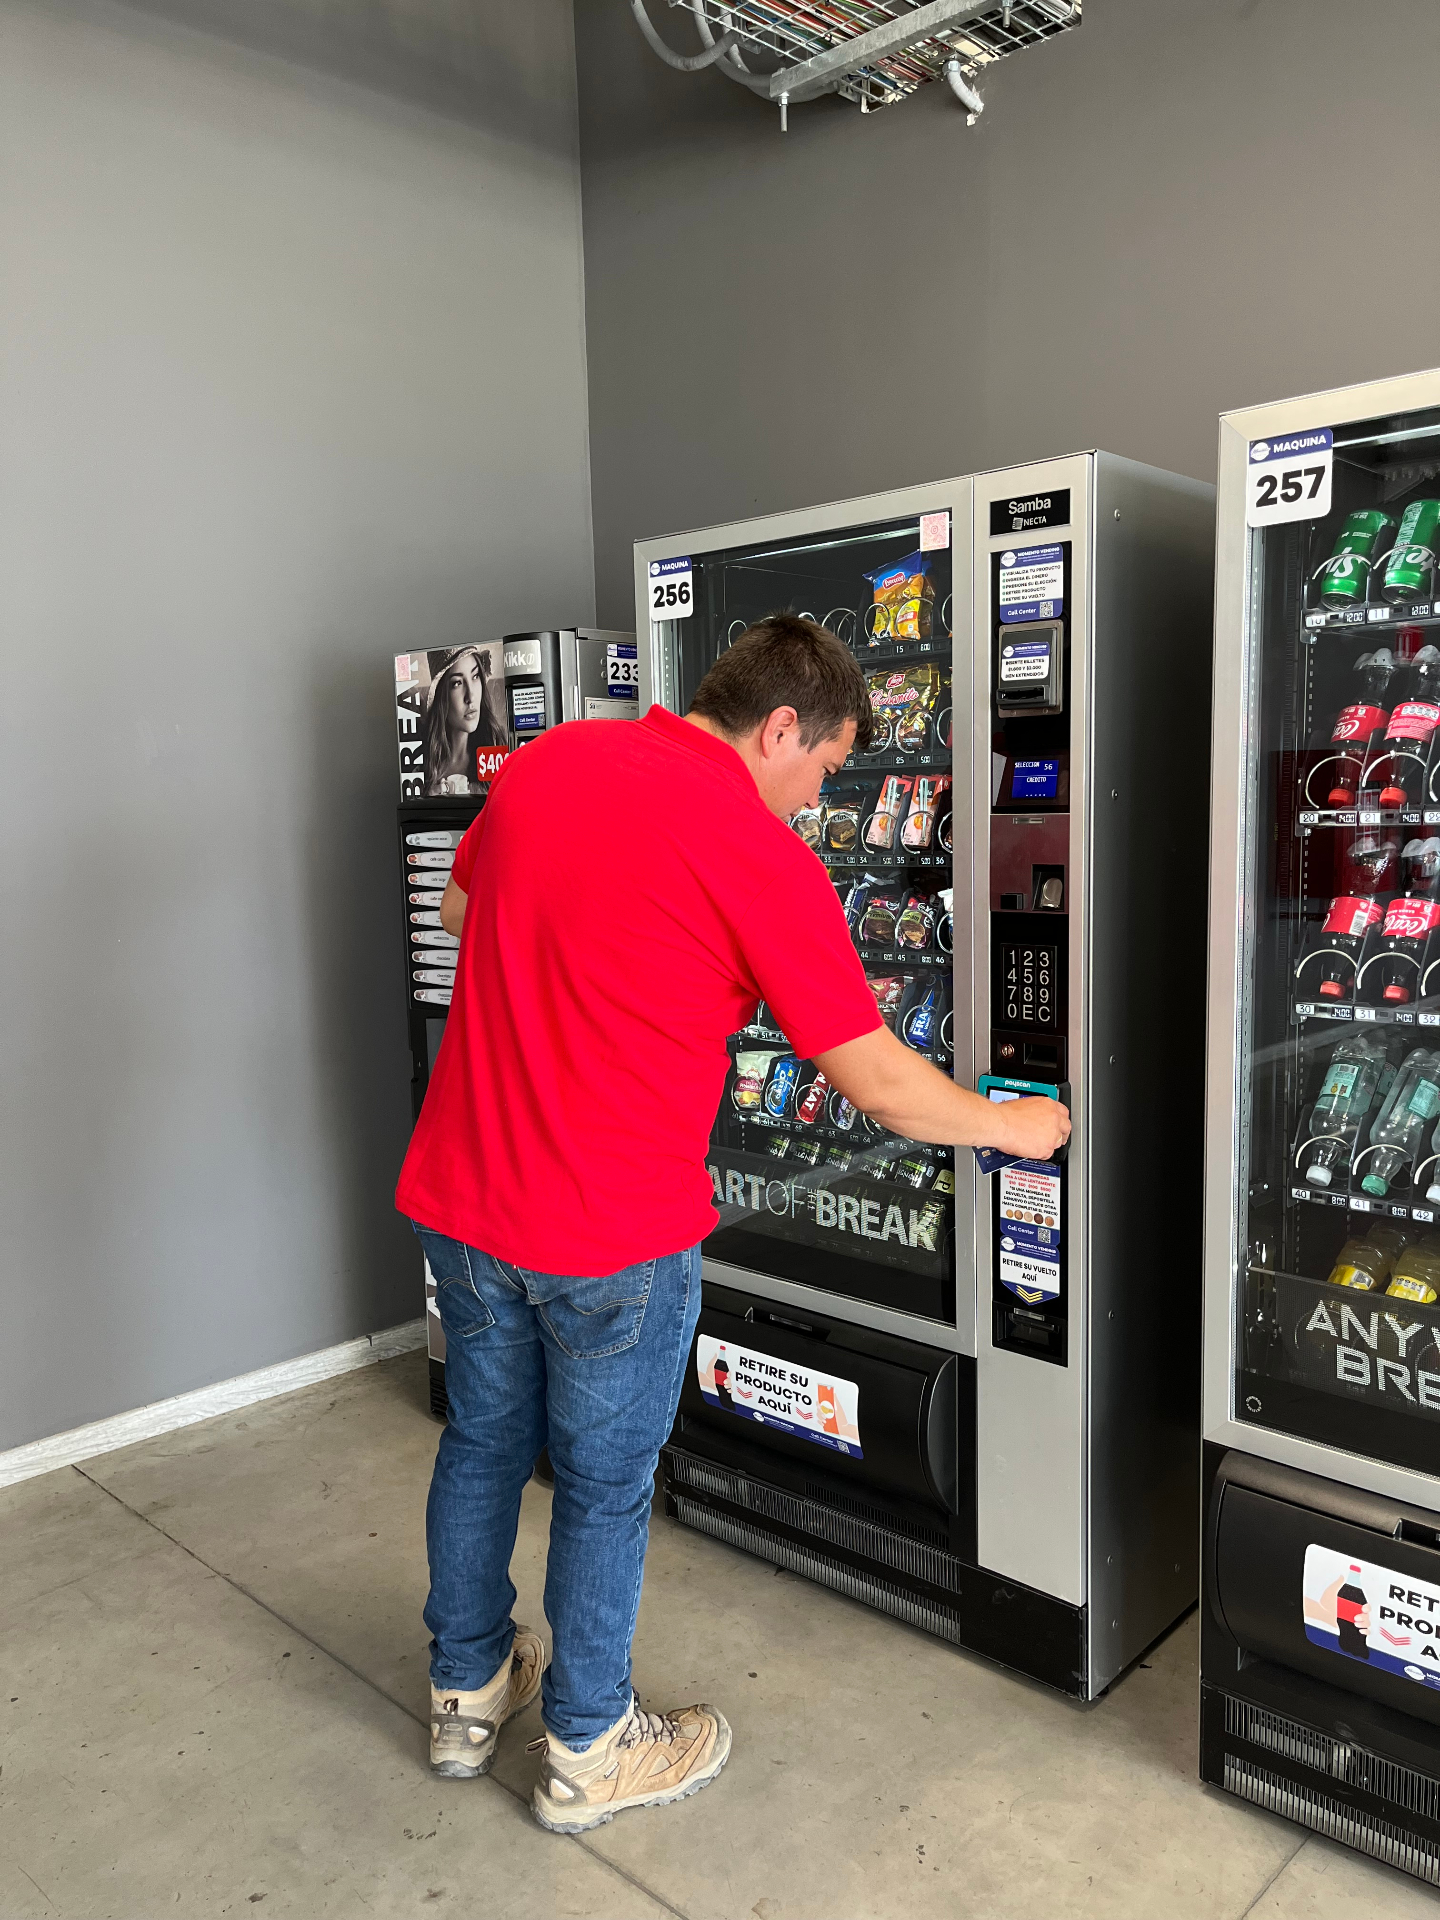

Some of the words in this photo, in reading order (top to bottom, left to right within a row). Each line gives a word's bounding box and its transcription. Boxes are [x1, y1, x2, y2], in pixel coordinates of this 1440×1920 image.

[1273, 434, 1326, 453] MAQUINA
[1255, 465, 1326, 508] 257
[1008, 497, 1052, 515] Samba
[1023, 516, 1047, 527] NECTA
[661, 560, 689, 572] MAQUINA
[653, 581, 690, 608] 256
[610, 661, 638, 682] 233
[479, 752, 510, 777] $40
[1043, 763, 1053, 771] 56
[1303, 814, 1315, 822] 20
[1364, 813, 1376, 822] 21
[935, 956, 945, 964] 46
[1009, 950, 1016, 965] 1
[1023, 951, 1033, 966] 2
[1039, 952, 1049, 967] 3
[1007, 968, 1017, 983] 4
[1023, 969, 1033, 984] 5
[1040, 970, 1050, 985] 6
[1007, 985, 1017, 1000] 7
[1023, 987, 1033, 1002] 8
[1040, 988, 1049, 1003] 9
[1007, 1003, 1017, 1018] 0
[1022, 1004, 1034, 1020] E
[1038, 1006, 1051, 1022] C
[1299, 1005, 1311, 1013] 30
[1360, 1010, 1371, 1019] 31
[1422, 1014, 1436, 1024] 32
[937, 1054, 946, 1062] 56
[1004, 1080, 1031, 1088] payscan
[899, 1143, 908, 1151] 65
[937, 1150, 947, 1158] 66
[707, 1164, 766, 1211] ART
[766, 1180, 806, 1219] OF
[815, 1189, 937, 1252] BREAK
[1294, 1190, 1307, 1198] 40
[1354, 1200, 1366, 1209] 41
[1416, 1211, 1430, 1219] 42
[1002, 1258, 1023, 1269] RETIRE
[1023, 1263, 1032, 1271] SU
[1033, 1265, 1057, 1276] VUELTO
[1022, 1273, 1037, 1282] AQUÍ
[739, 1355, 787, 1381] RETIRE
[789, 1372, 809, 1388] SU
[735, 1371, 813, 1406] PRODUCTO
[757, 1394, 792, 1415] AQUÍ
